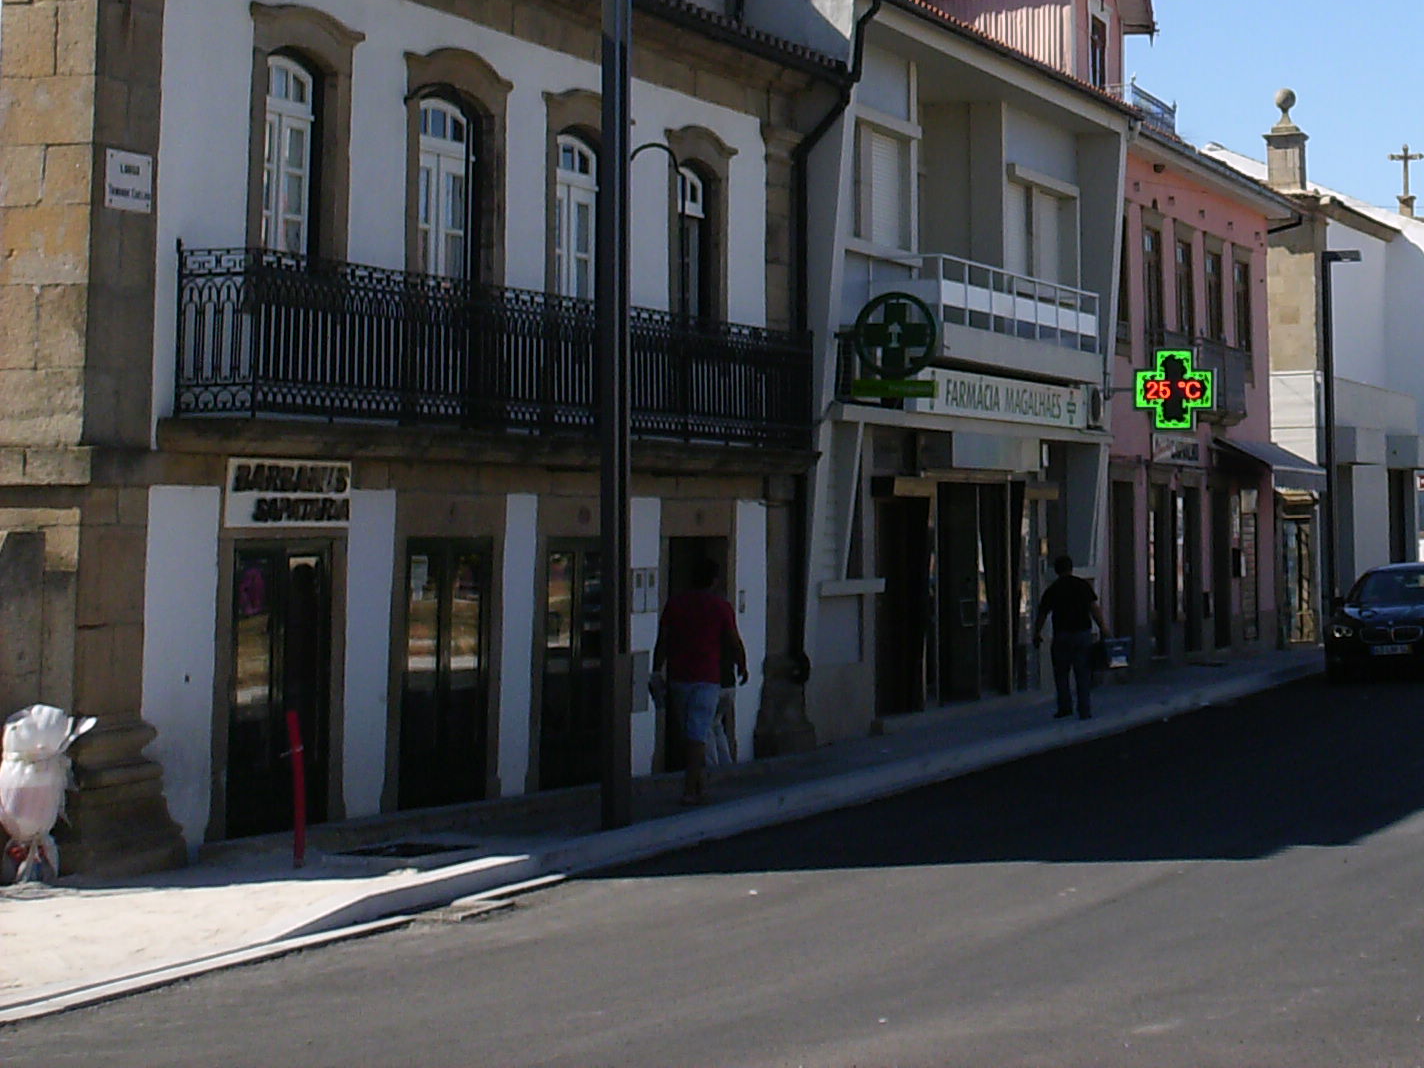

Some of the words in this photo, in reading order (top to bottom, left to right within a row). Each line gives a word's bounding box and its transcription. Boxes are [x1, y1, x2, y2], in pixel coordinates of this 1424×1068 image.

[945, 377, 1000, 413] FARMÁCIA
[1146, 381, 1171, 399] 25
[1177, 381, 1201, 399] °C
